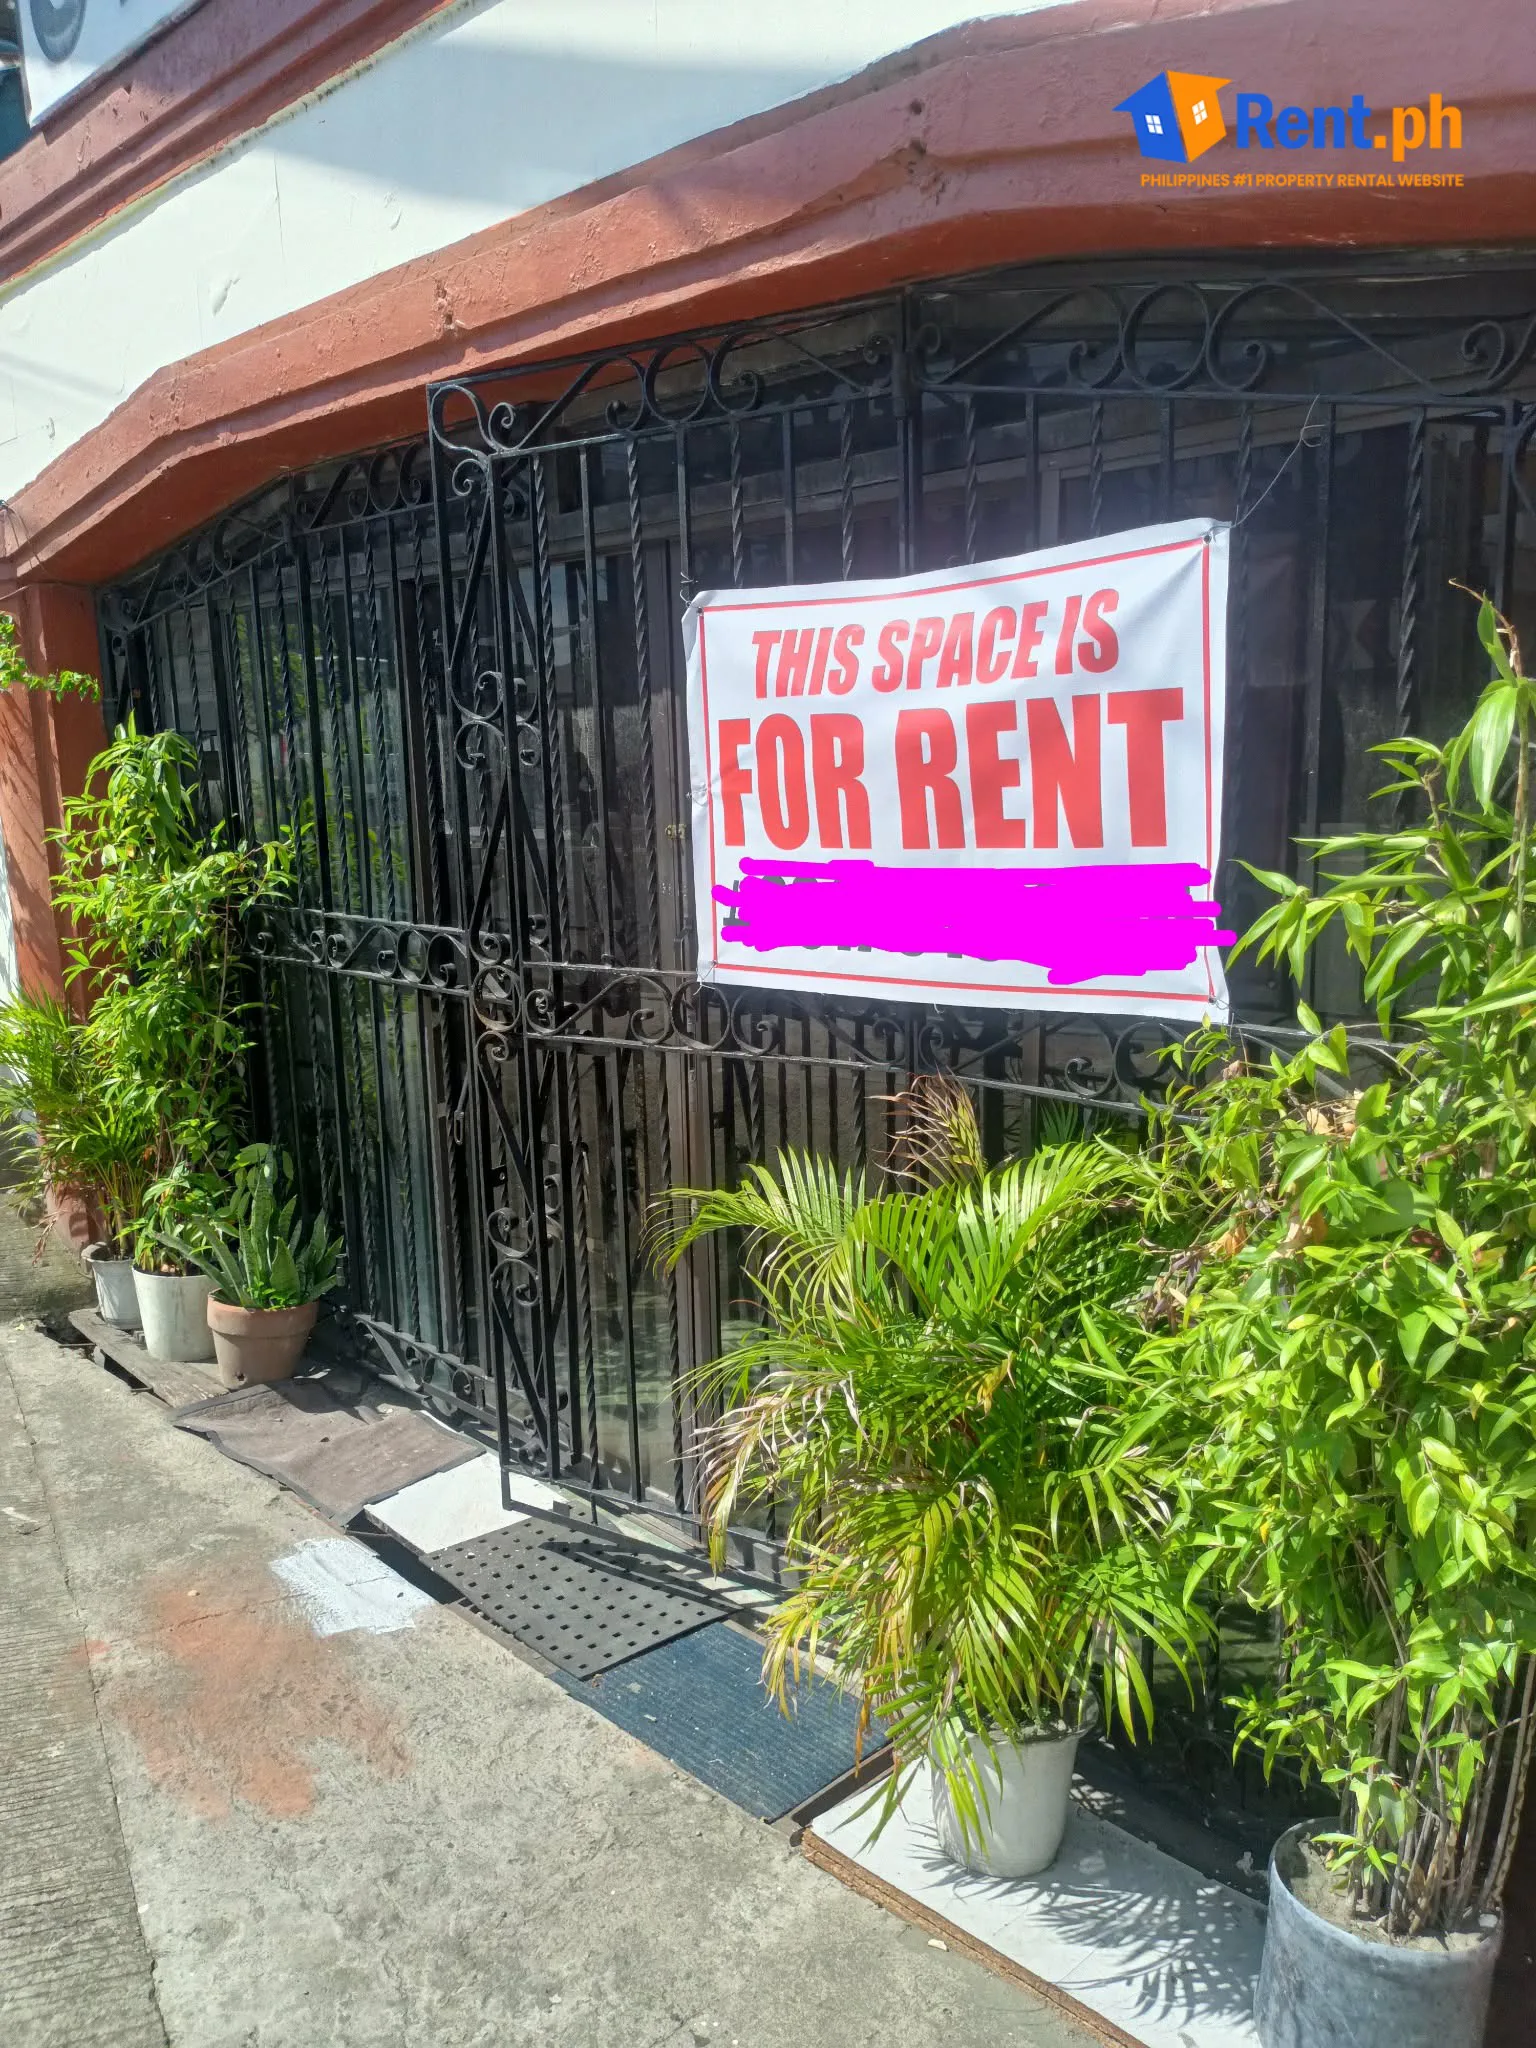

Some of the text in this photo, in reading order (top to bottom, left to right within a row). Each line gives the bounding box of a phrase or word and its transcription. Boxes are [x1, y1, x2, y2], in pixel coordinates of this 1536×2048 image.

[751, 588, 1120, 699] THIS SPACE IS
[717, 687, 1184, 851] FOR RENT
